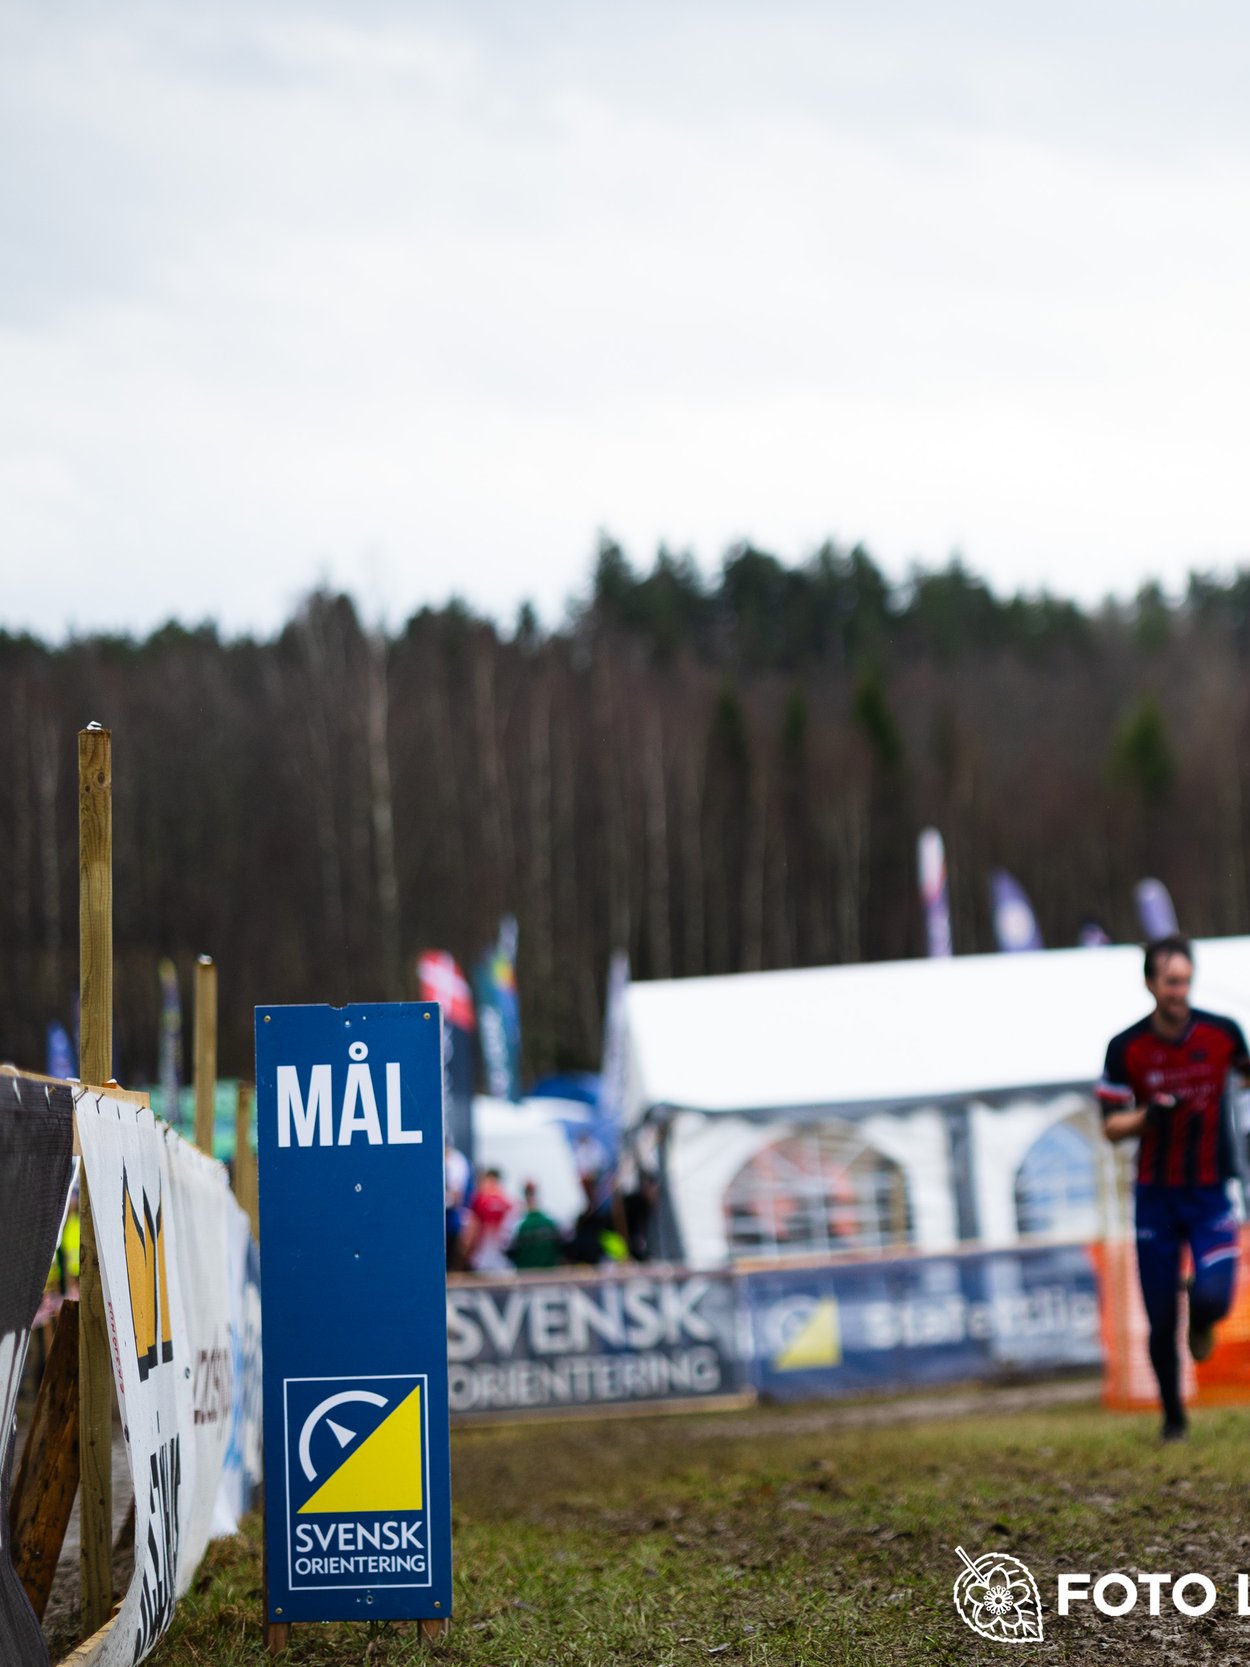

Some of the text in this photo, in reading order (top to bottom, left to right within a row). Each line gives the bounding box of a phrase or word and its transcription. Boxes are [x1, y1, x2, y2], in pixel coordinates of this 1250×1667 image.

[277, 1041, 423, 1148] MÅL
[446, 1276, 717, 1362] SVENSK
[448, 1345, 720, 1411] ORIENTERING
[295, 1521, 425, 1553] SVENSK
[295, 1554, 426, 1575] ORIENTERING
